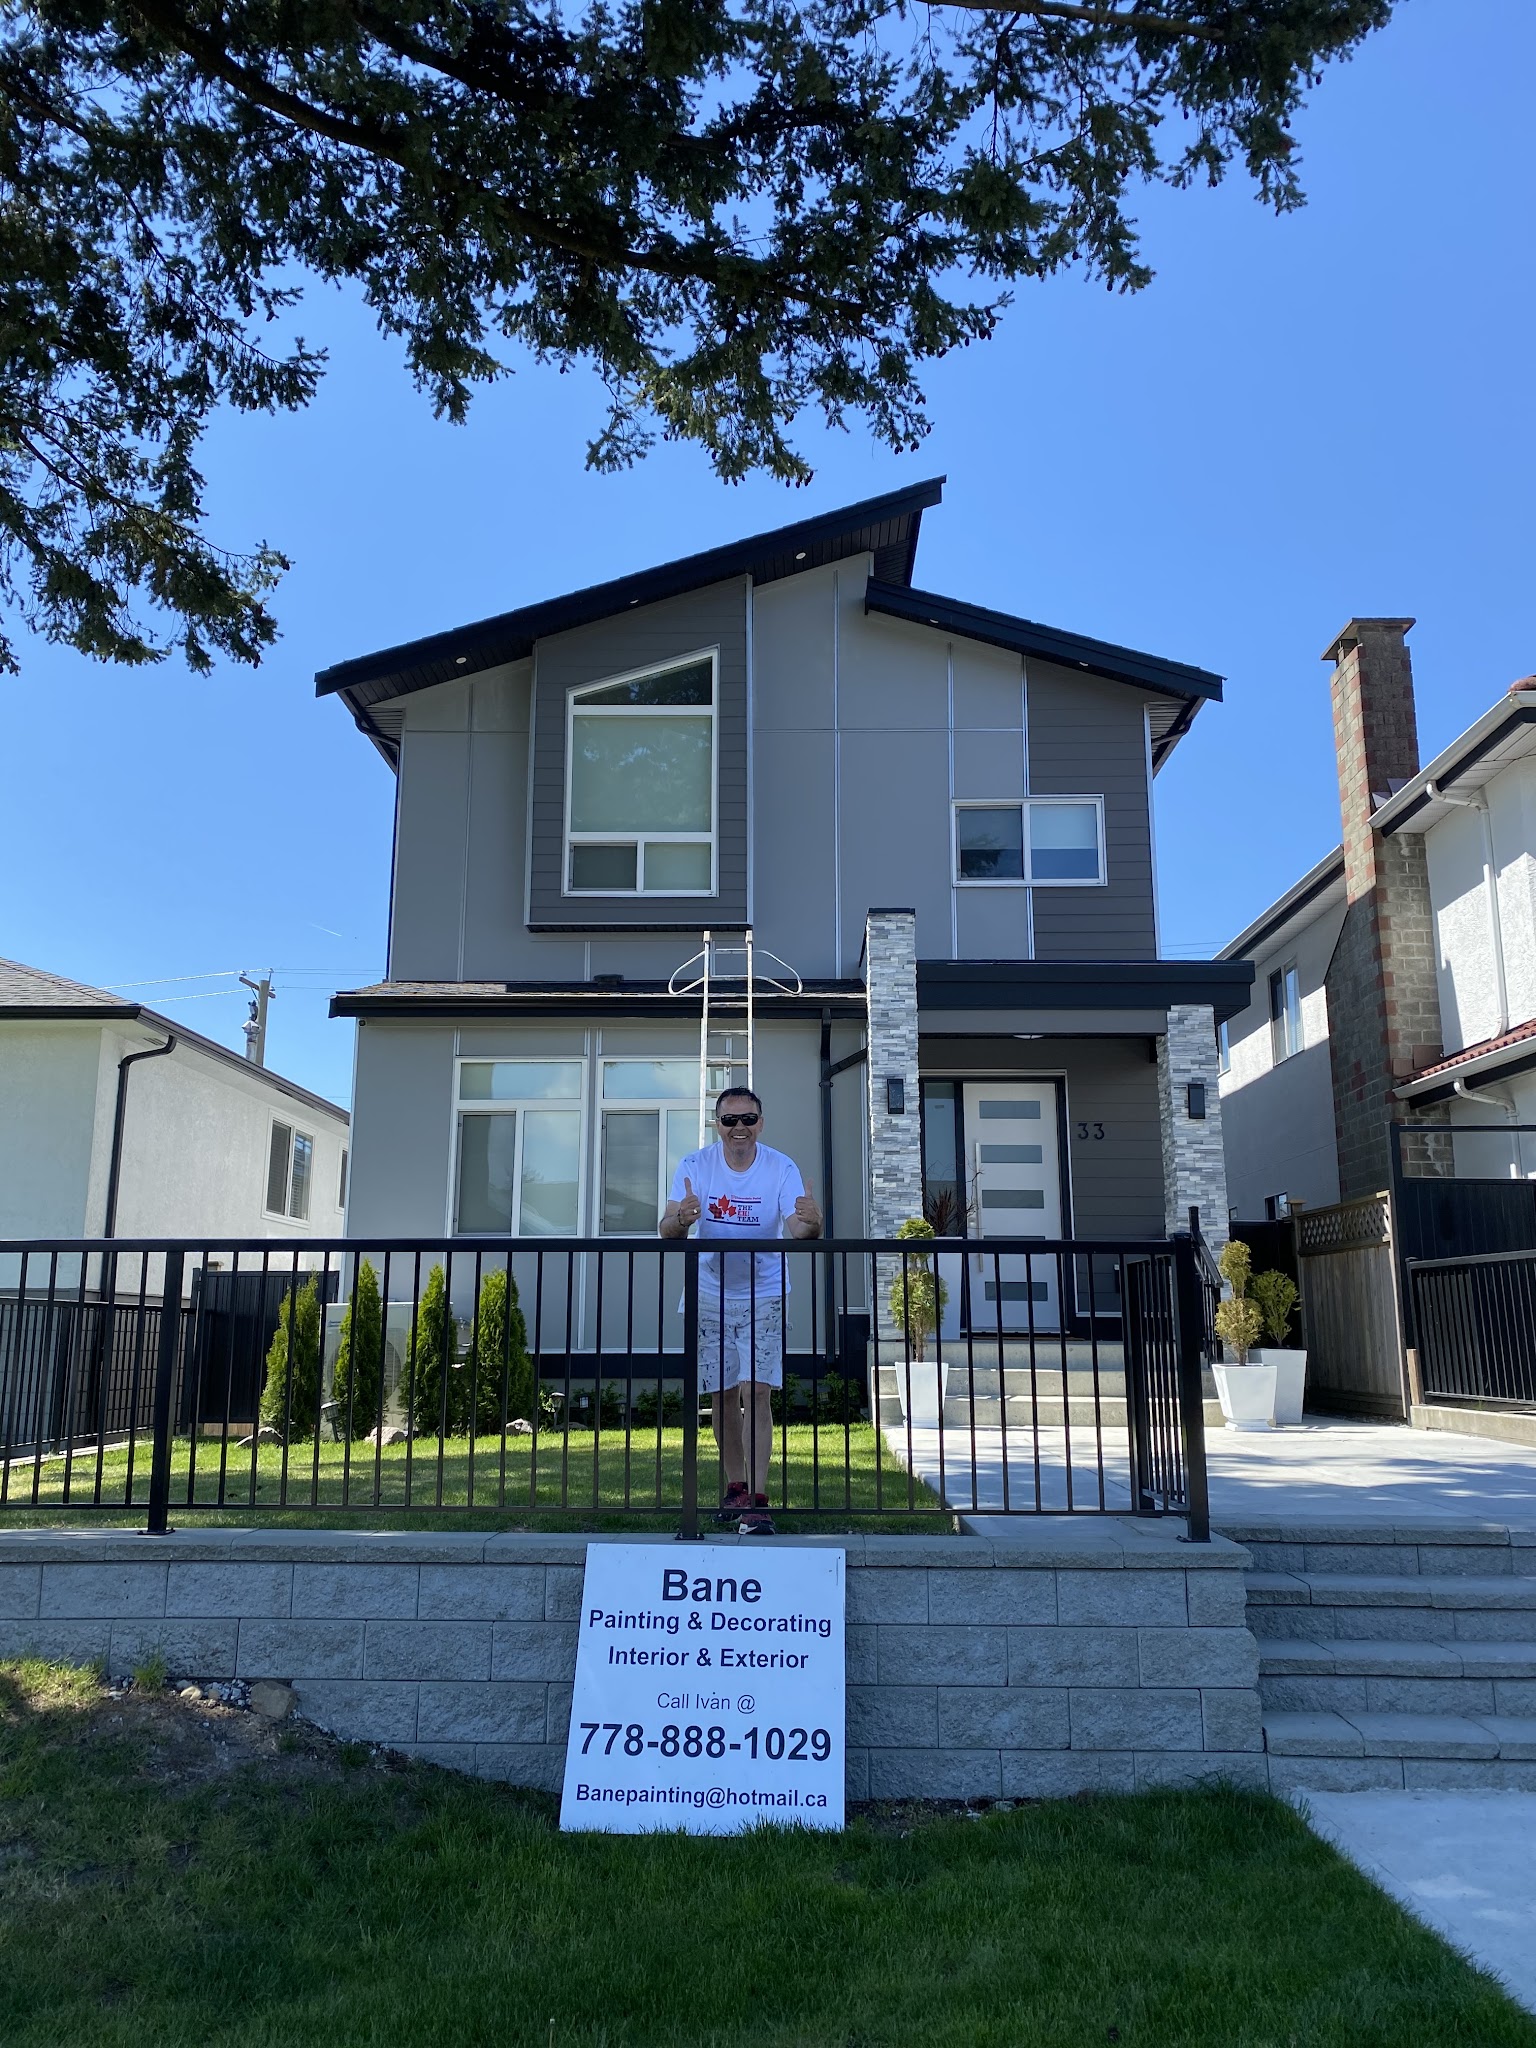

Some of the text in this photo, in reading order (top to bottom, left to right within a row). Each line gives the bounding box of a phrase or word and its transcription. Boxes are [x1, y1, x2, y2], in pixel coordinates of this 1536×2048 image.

[1078, 1122, 1105, 1140] 33
[661, 1568, 762, 1604] Bane
[589, 1609, 832, 1638] Painting & Decorating
[608, 1645, 810, 1669] Interior & Exterior
[657, 1692, 756, 1715] Call Ivan @
[579, 1722, 832, 1762] 778-888-1029
[576, 1783, 828, 1809] Banepainting@hotmail.ca
